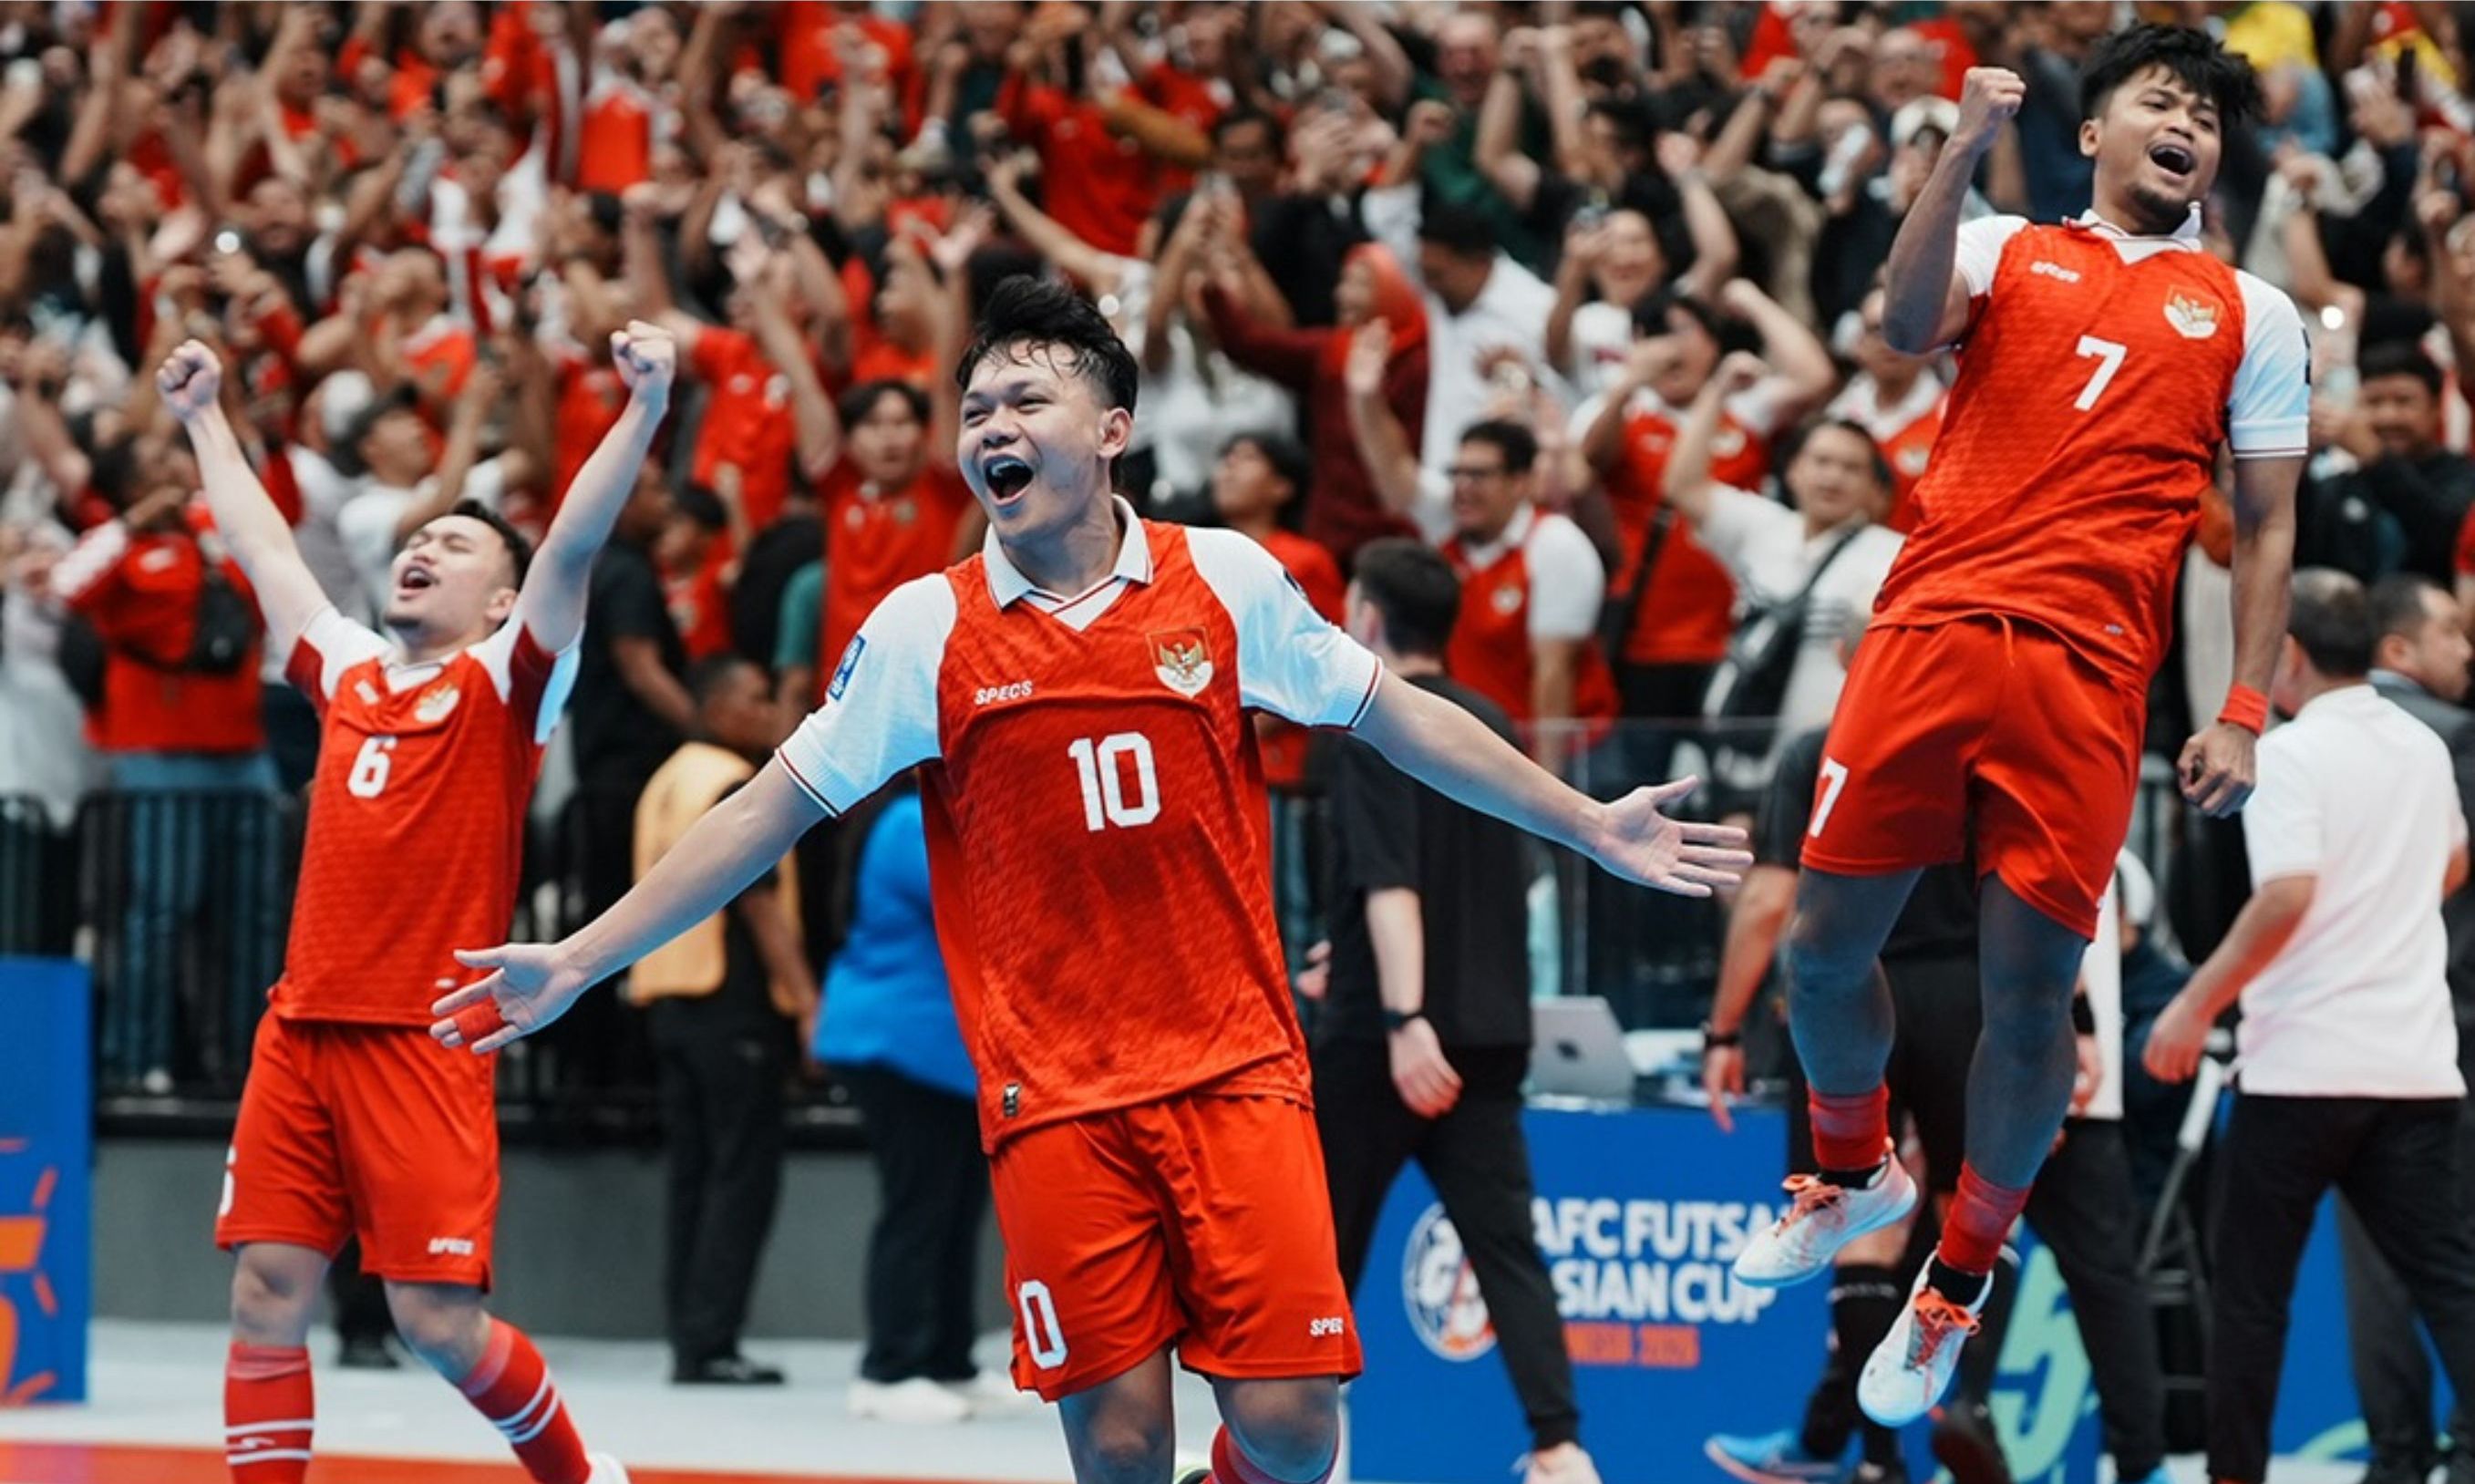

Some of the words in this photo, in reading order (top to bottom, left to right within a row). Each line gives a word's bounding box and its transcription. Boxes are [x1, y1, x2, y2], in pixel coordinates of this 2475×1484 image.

[2073, 335, 2128, 412] 7
[975, 680, 1032, 705] SPECS
[347, 734, 398, 799] 6
[1067, 731, 1161, 832] 10
[1809, 756, 1849, 838] 7
[1624, 1199, 1788, 1260] FUTSA
[1019, 1279, 1068, 1369] 0
[1552, 1259, 1669, 1321] SIAN
